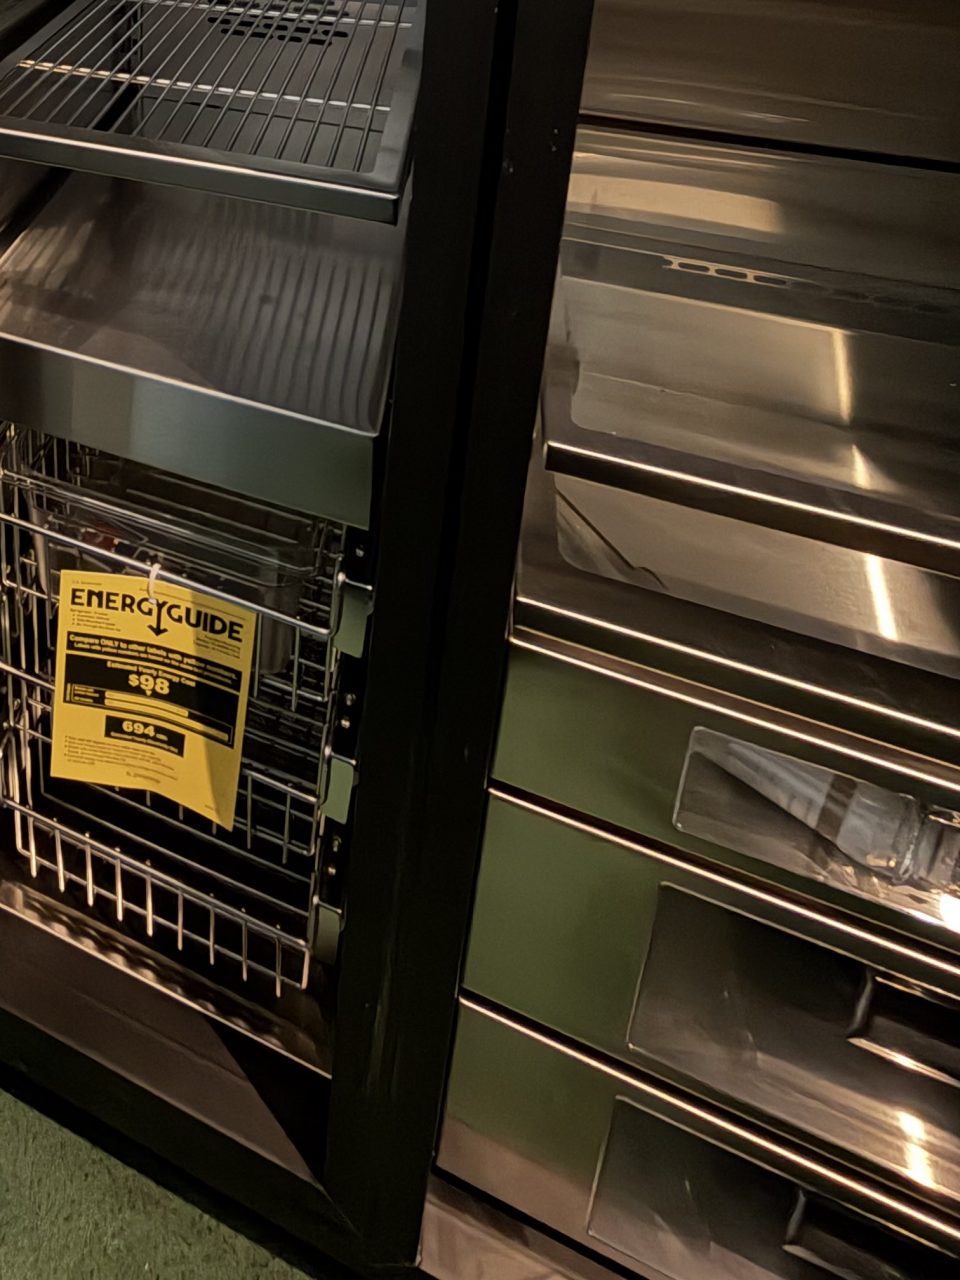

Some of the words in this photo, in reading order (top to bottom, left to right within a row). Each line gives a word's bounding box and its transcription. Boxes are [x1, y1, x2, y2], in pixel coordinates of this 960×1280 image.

[71, 588, 244, 642] ENERGYGUIDE
[128, 673, 170, 695] $98
[122, 720, 155, 737] 694
